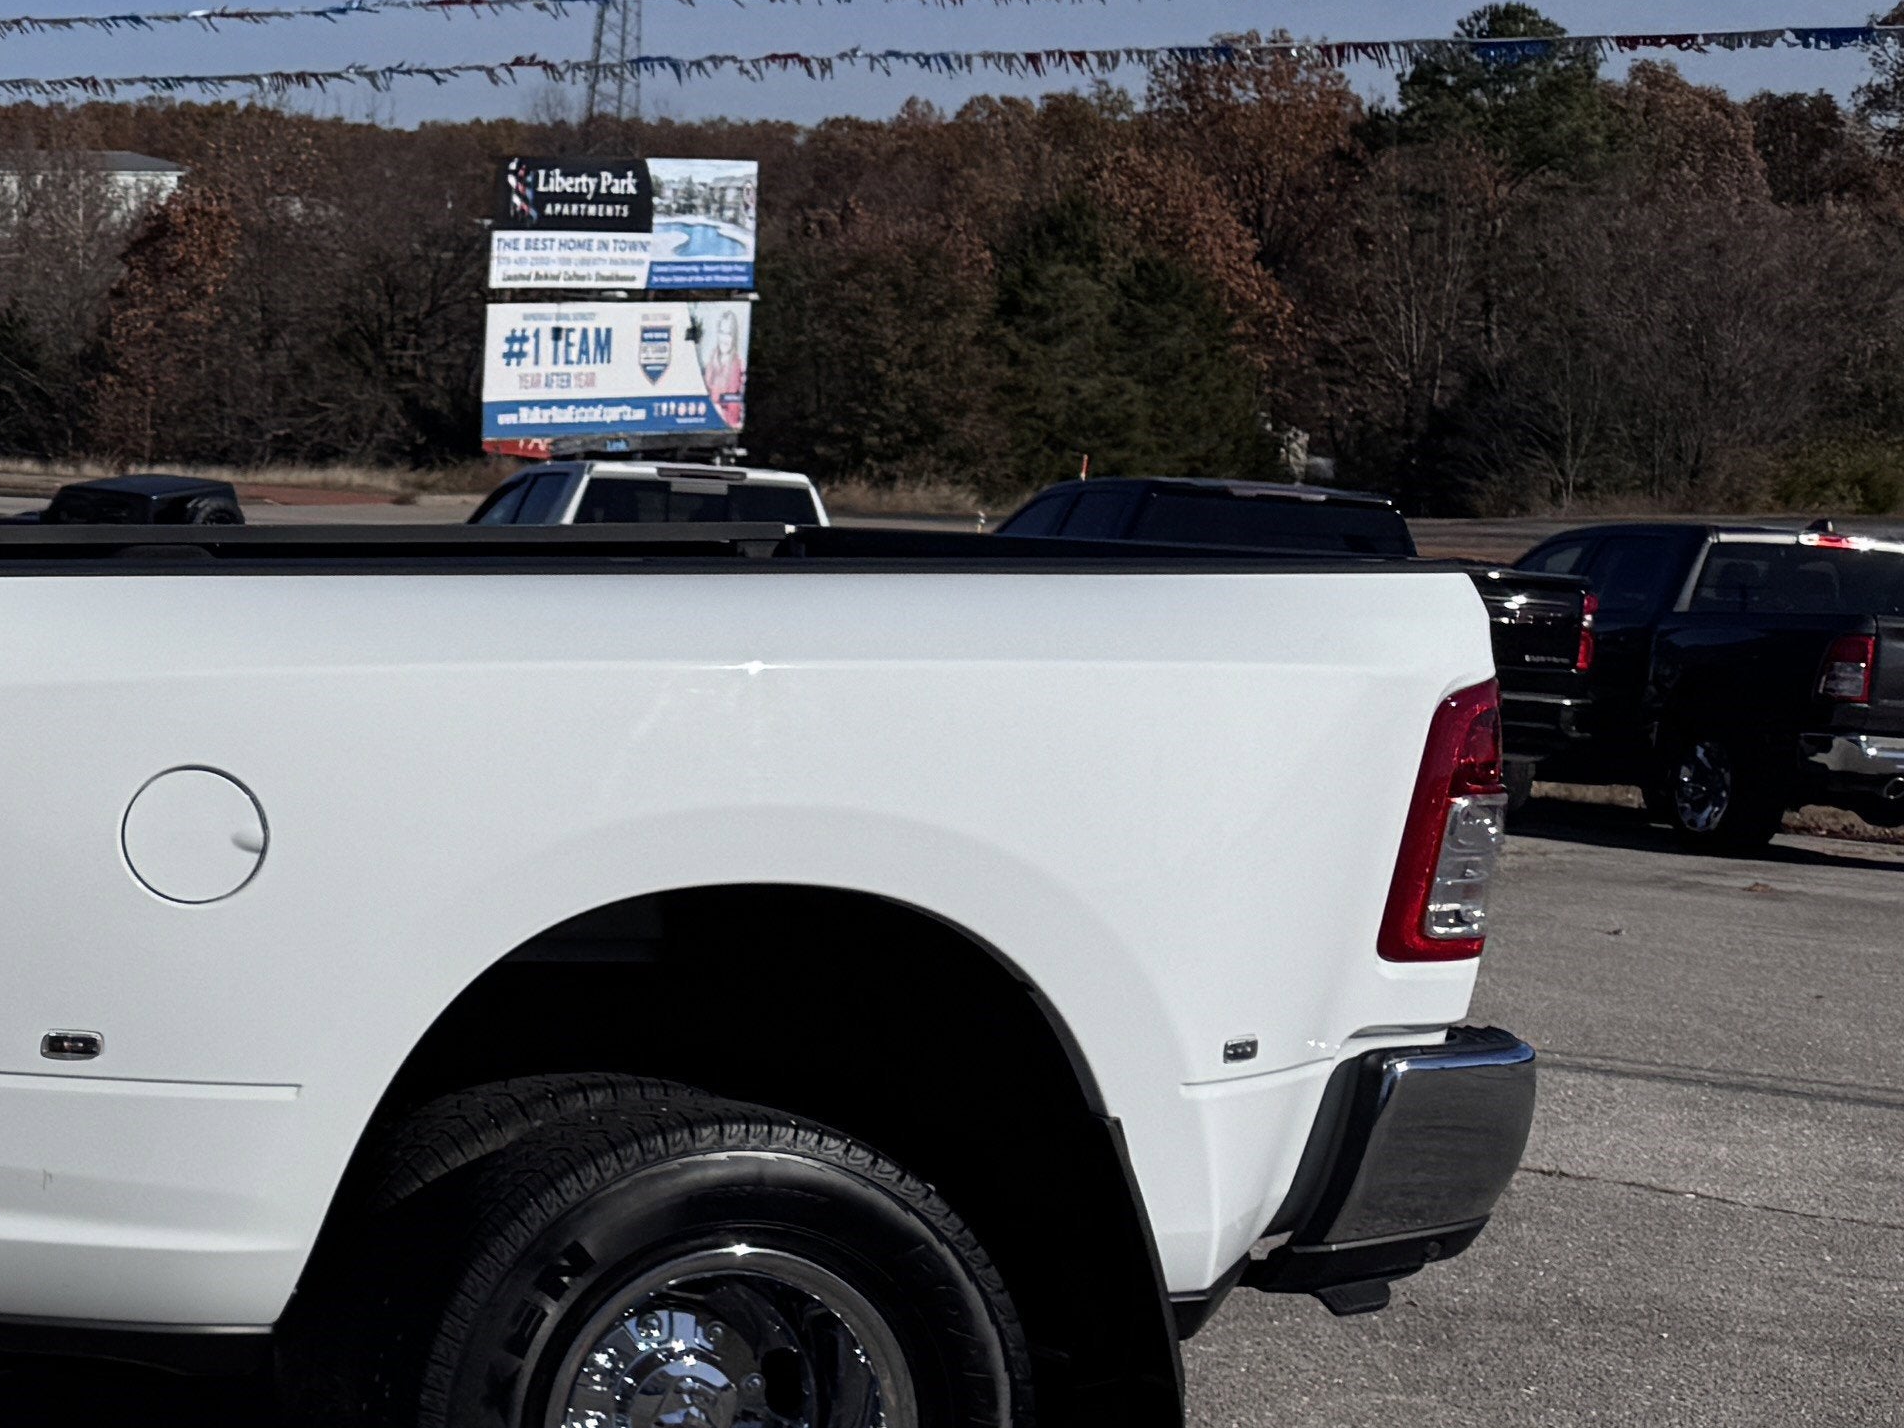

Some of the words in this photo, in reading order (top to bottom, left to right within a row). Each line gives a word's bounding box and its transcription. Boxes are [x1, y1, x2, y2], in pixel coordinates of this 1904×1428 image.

[537, 168, 598, 200] Liberty
[600, 170, 638, 194] Park
[544, 203, 630, 217] APARTMENTS
[497, 237, 520, 251] THE
[524, 237, 555, 251] BEST
[558, 238, 593, 252] HOME
[597, 239, 609, 252] IN
[502, 327, 540, 366] #1
[552, 327, 612, 365] TEAM
